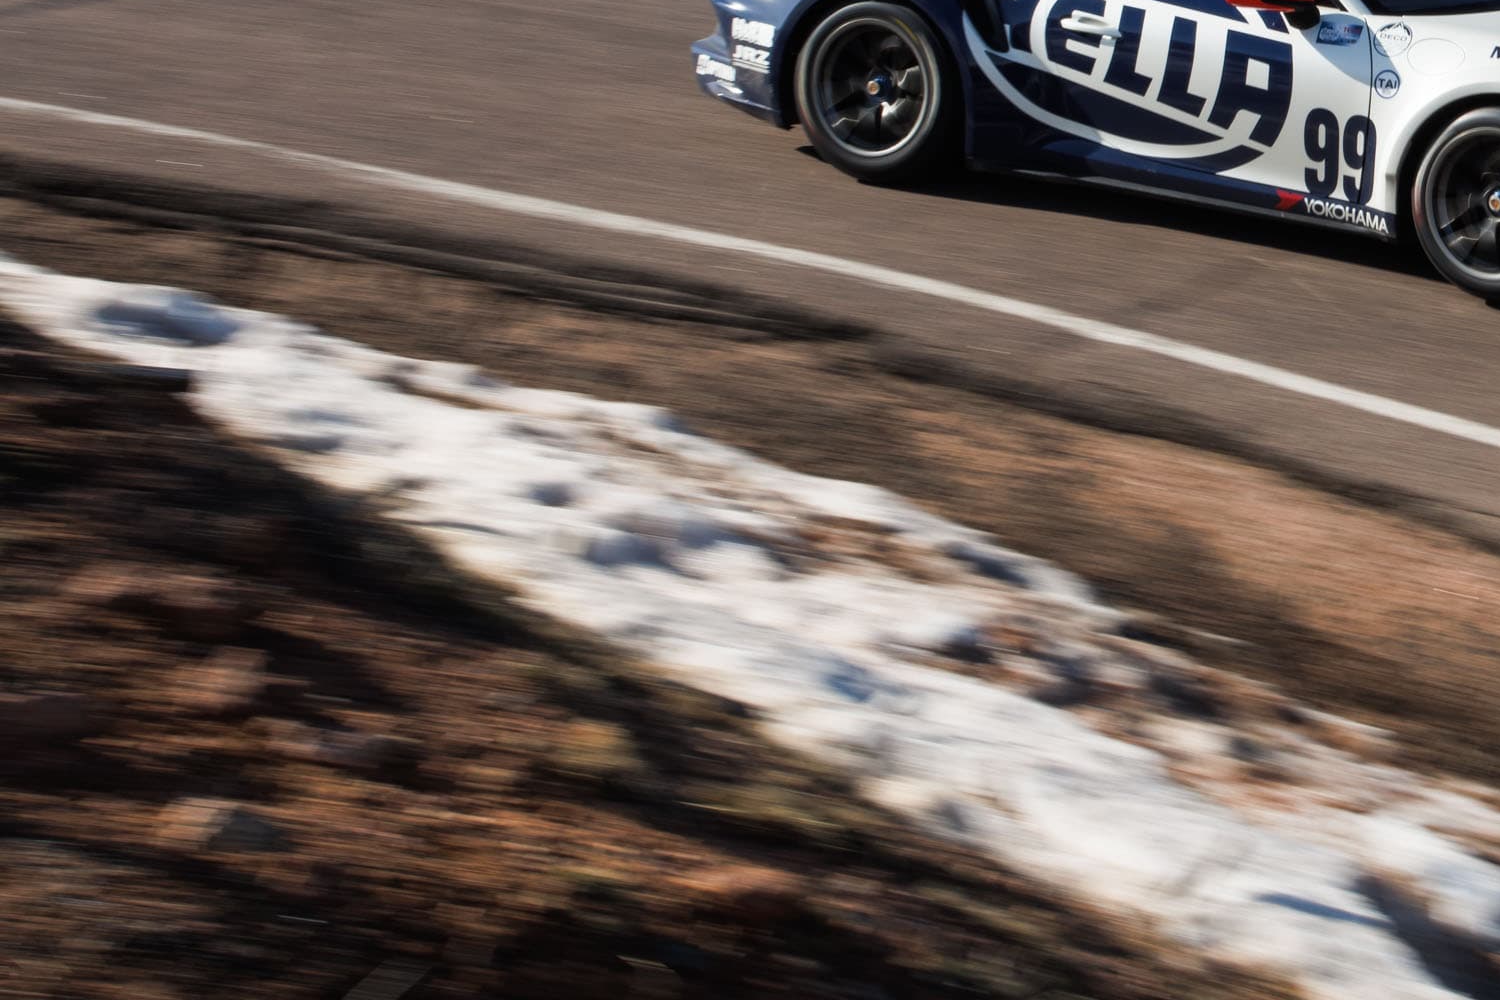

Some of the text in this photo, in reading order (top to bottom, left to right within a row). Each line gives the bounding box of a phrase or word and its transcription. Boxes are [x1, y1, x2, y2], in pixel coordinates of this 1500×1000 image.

[1378, 78, 1397, 89] TAI
[1304, 107, 1377, 206] 99
[1304, 197, 1389, 234] YOKOHAMA
